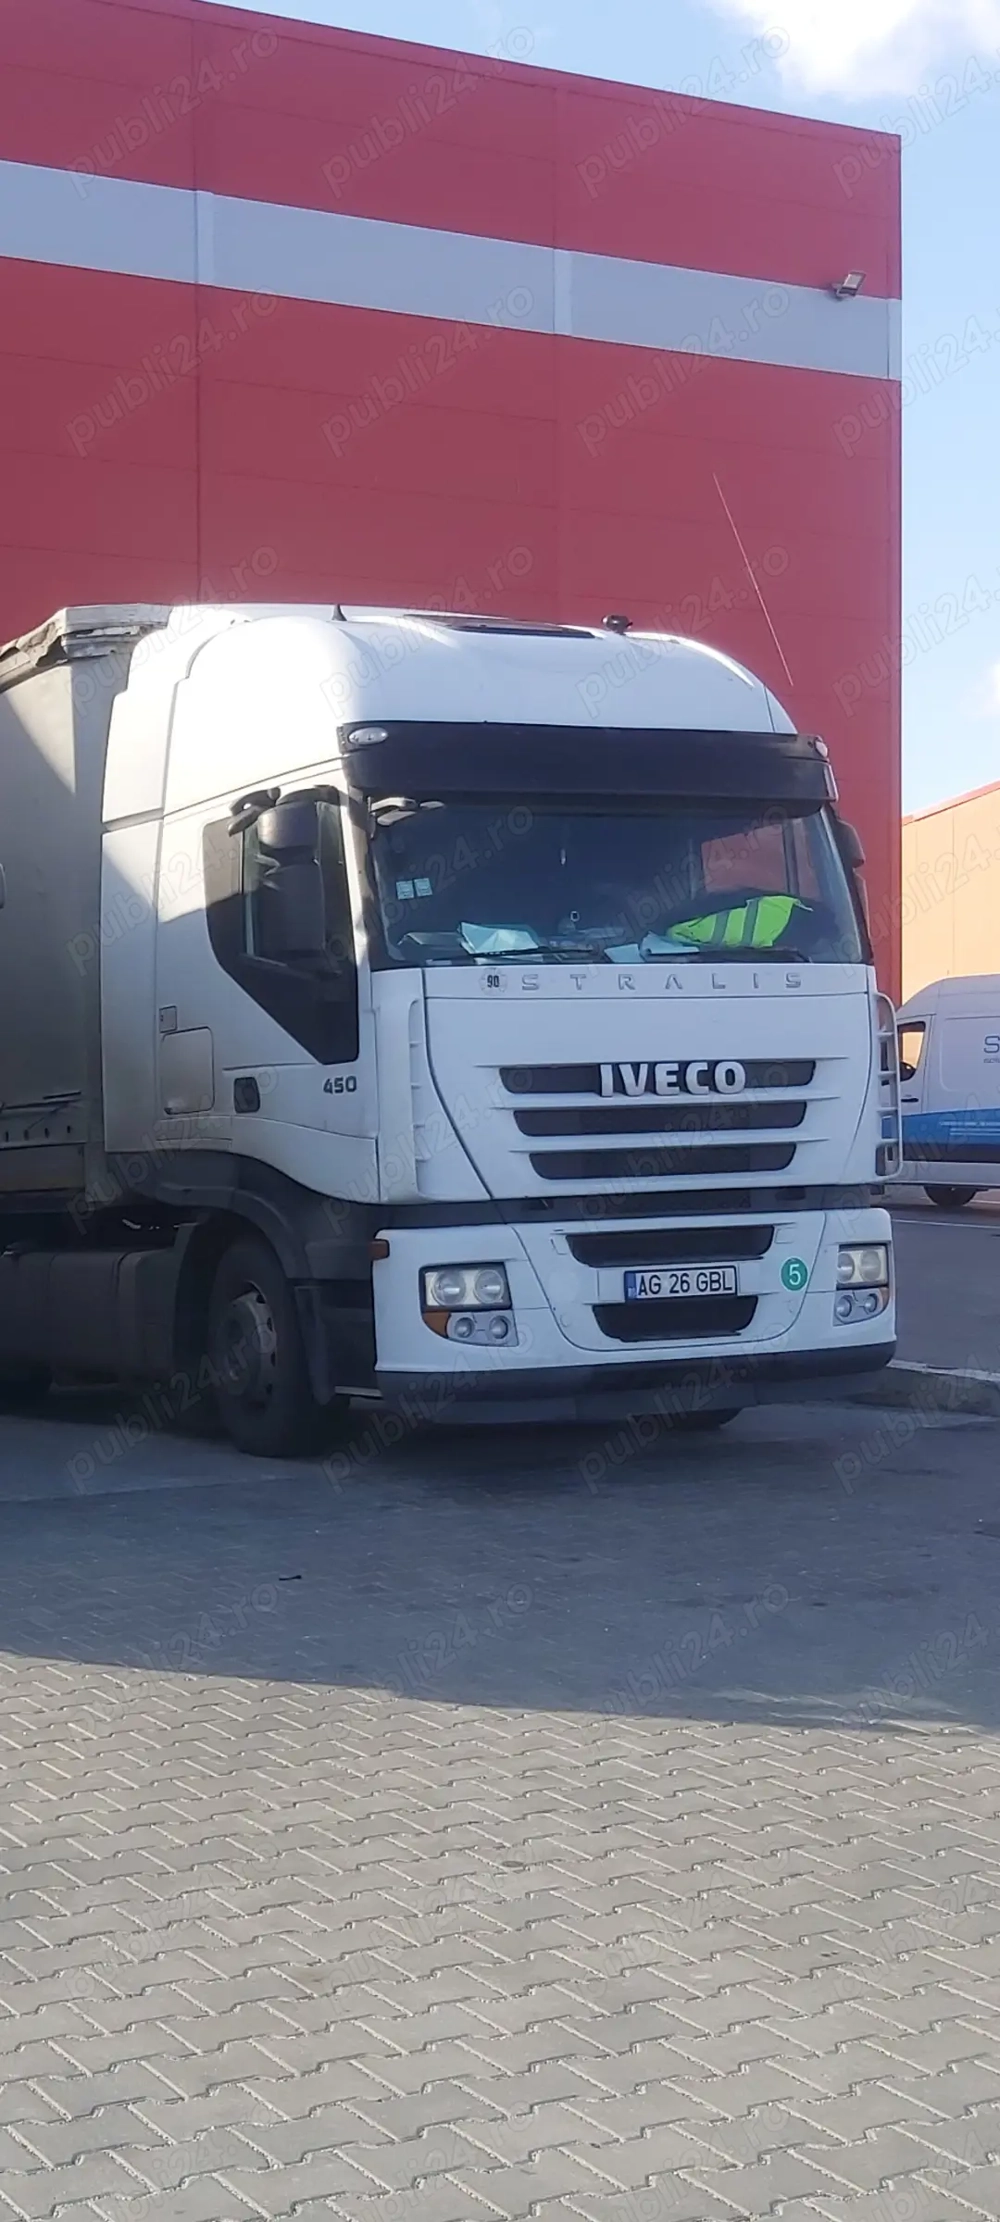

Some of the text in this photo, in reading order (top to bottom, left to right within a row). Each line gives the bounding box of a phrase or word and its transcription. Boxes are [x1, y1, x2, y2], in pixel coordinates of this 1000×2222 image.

[486, 974, 500, 988] 90
[521, 973, 801, 991] STRALIS
[323, 1076, 357, 1095] 450
[600, 1061, 746, 1097] IVECO
[637, 1275, 661, 1296] AG
[669, 1273, 690, 1294] 26
[696, 1271, 732, 1292] GBL
[788, 1264, 801, 1286] 5
